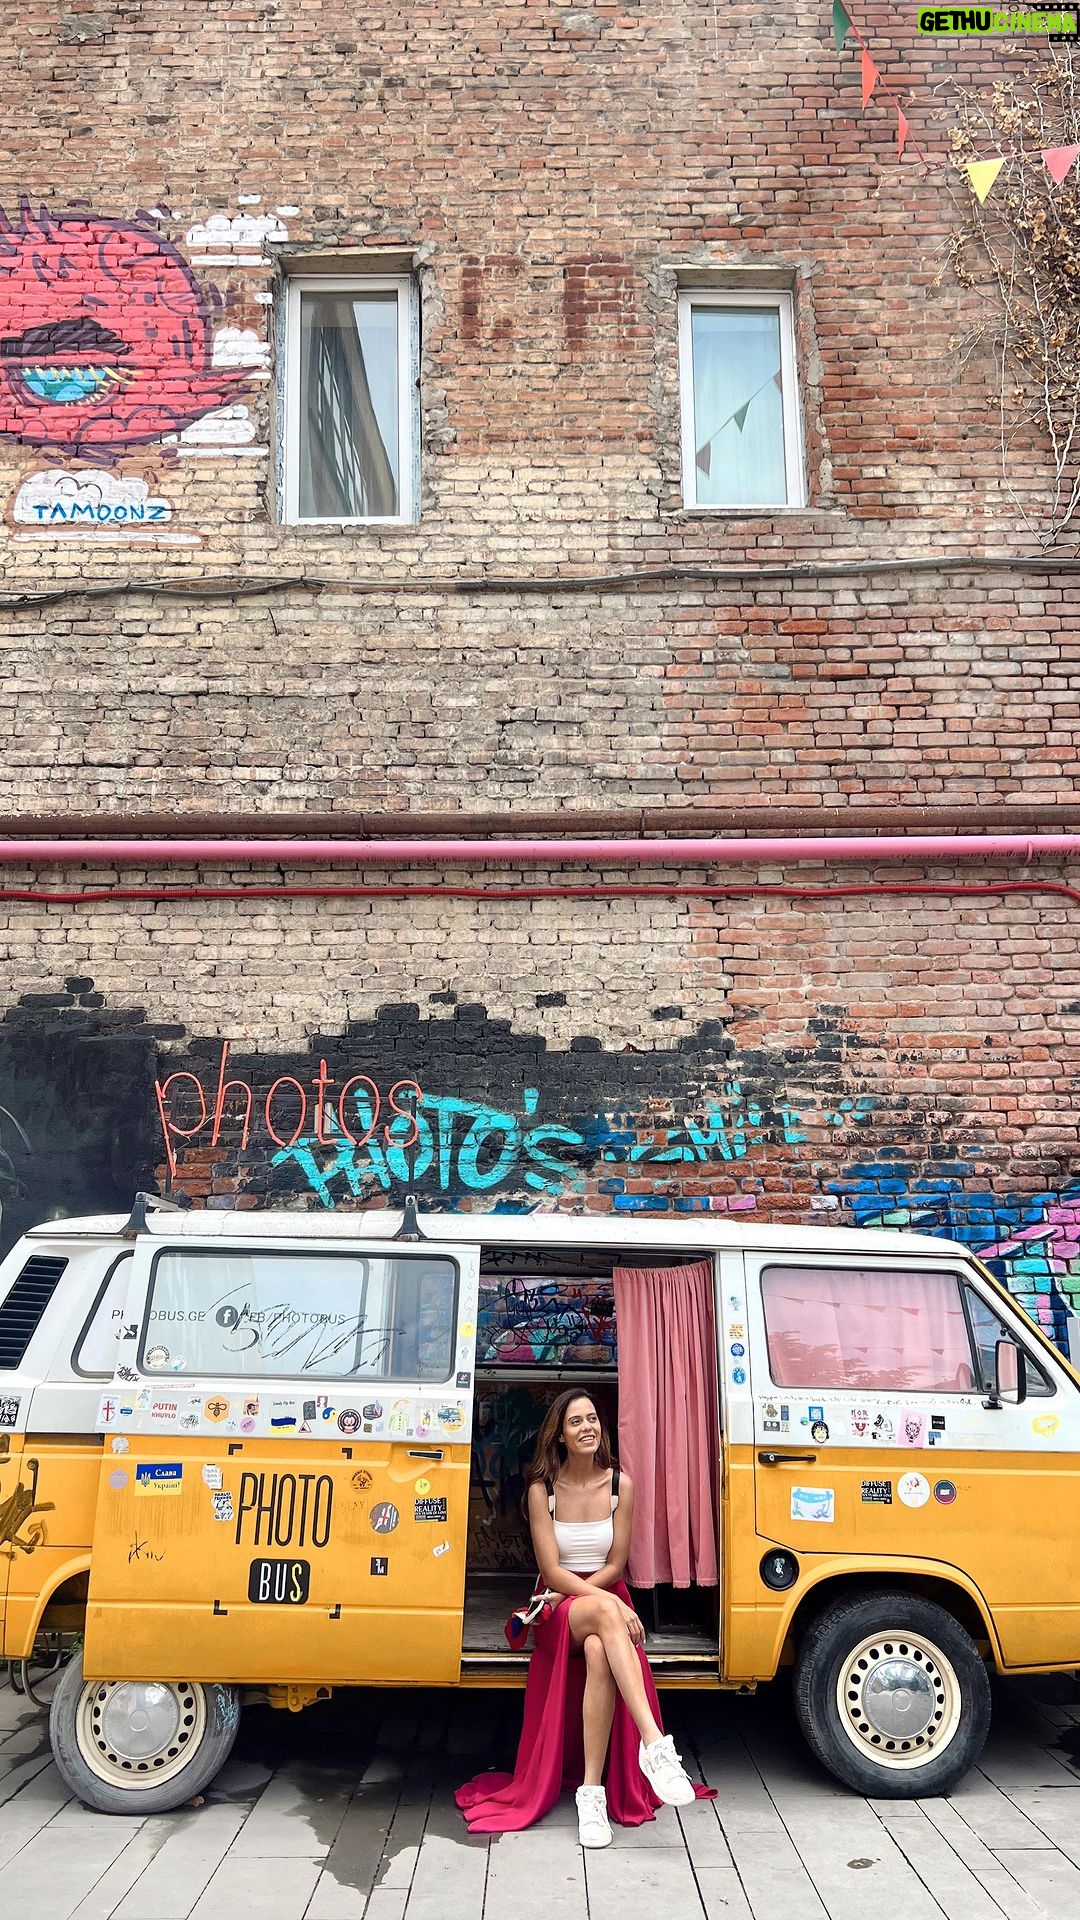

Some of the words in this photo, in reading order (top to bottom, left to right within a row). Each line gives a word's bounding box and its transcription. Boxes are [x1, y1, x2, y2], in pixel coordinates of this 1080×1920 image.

[33, 502, 166, 522] TAMOONZ
[154, 1040, 423, 1177] photos
[153, 1402, 178, 1411] PUTIN
[155, 1469, 177, 1477] Слава
[236, 1472, 334, 1548] PHOTO
[258, 1562, 304, 1602] BUS
